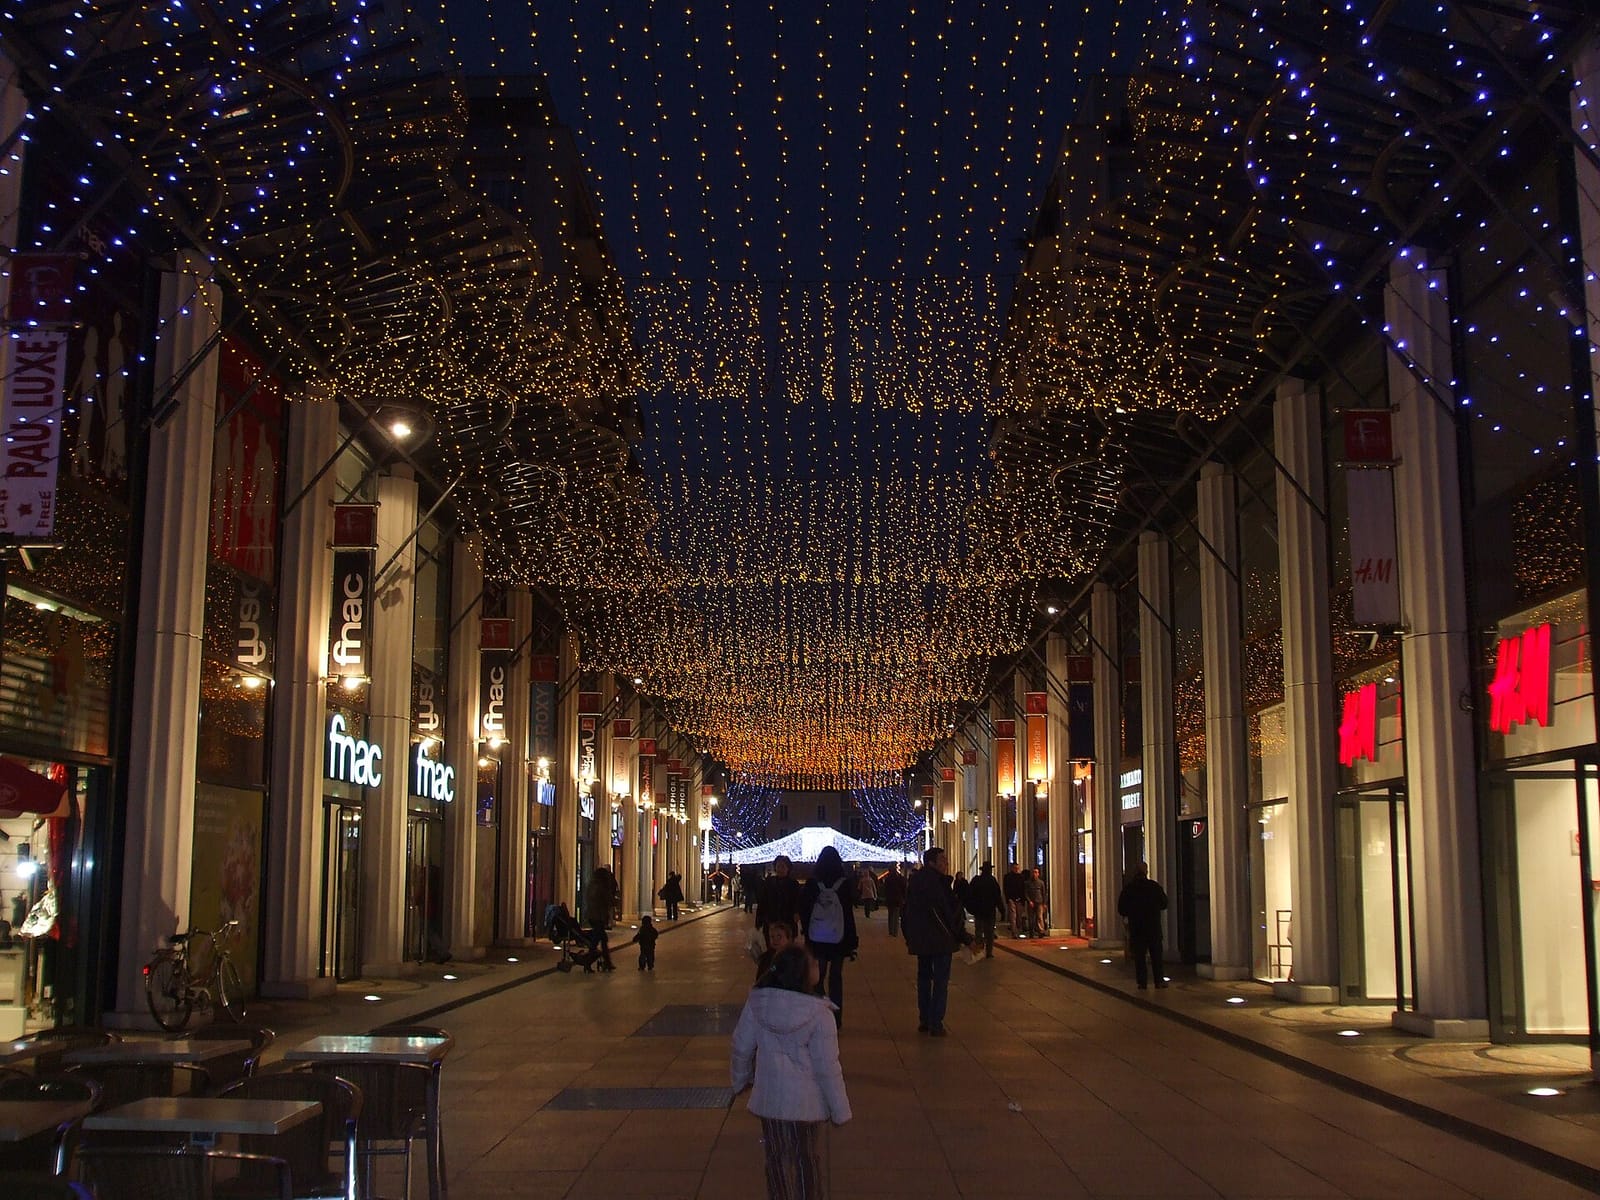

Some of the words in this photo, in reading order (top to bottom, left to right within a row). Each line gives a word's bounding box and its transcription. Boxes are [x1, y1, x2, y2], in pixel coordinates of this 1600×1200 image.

[12, 339, 59, 408] LUXE
[6, 422, 51, 478] PAU
[36, 490, 51, 528] FREE
[332, 572, 364, 667] fnac
[483, 665, 505, 732] fnac
[535, 687, 550, 737] ROXY
[329, 713, 382, 788] fnac
[416, 742, 456, 803] fnac
